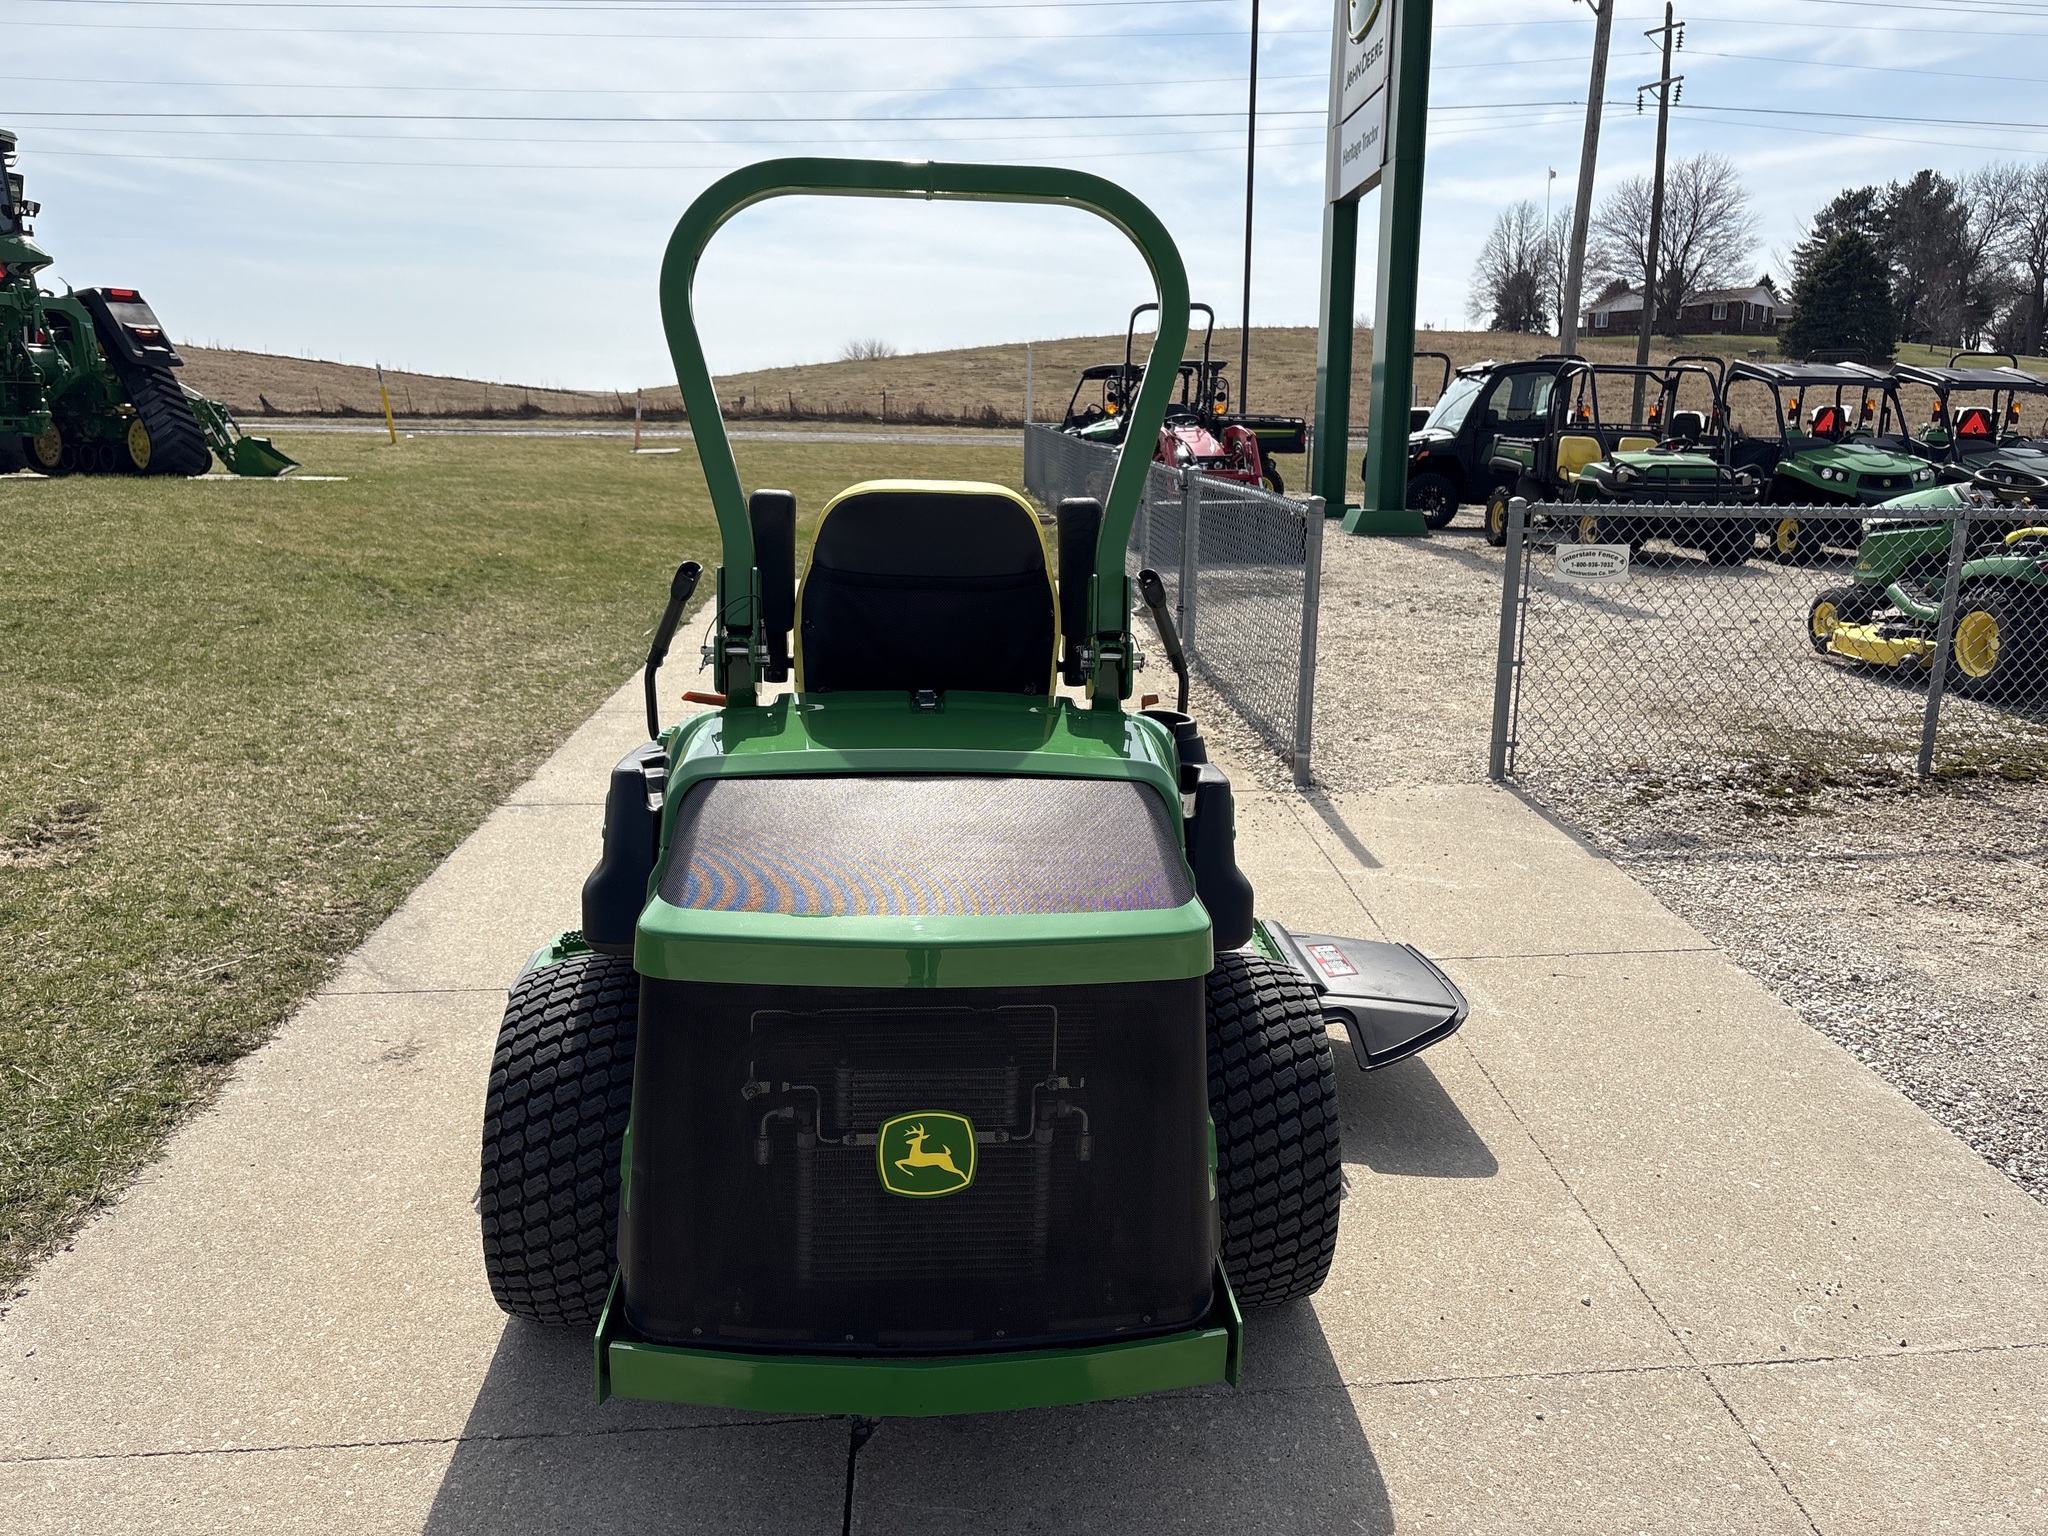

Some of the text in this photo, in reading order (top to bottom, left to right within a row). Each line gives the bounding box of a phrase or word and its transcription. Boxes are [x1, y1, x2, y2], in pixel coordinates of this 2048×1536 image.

[1345, 37, 1383, 92] JOHN DEERE
[1342, 125, 1379, 167] Heritage Tractor
[1562, 551, 1596, 563] Interstate
[1598, 551, 1619, 561] Fence
[1565, 568, 1597, 576] Construction
